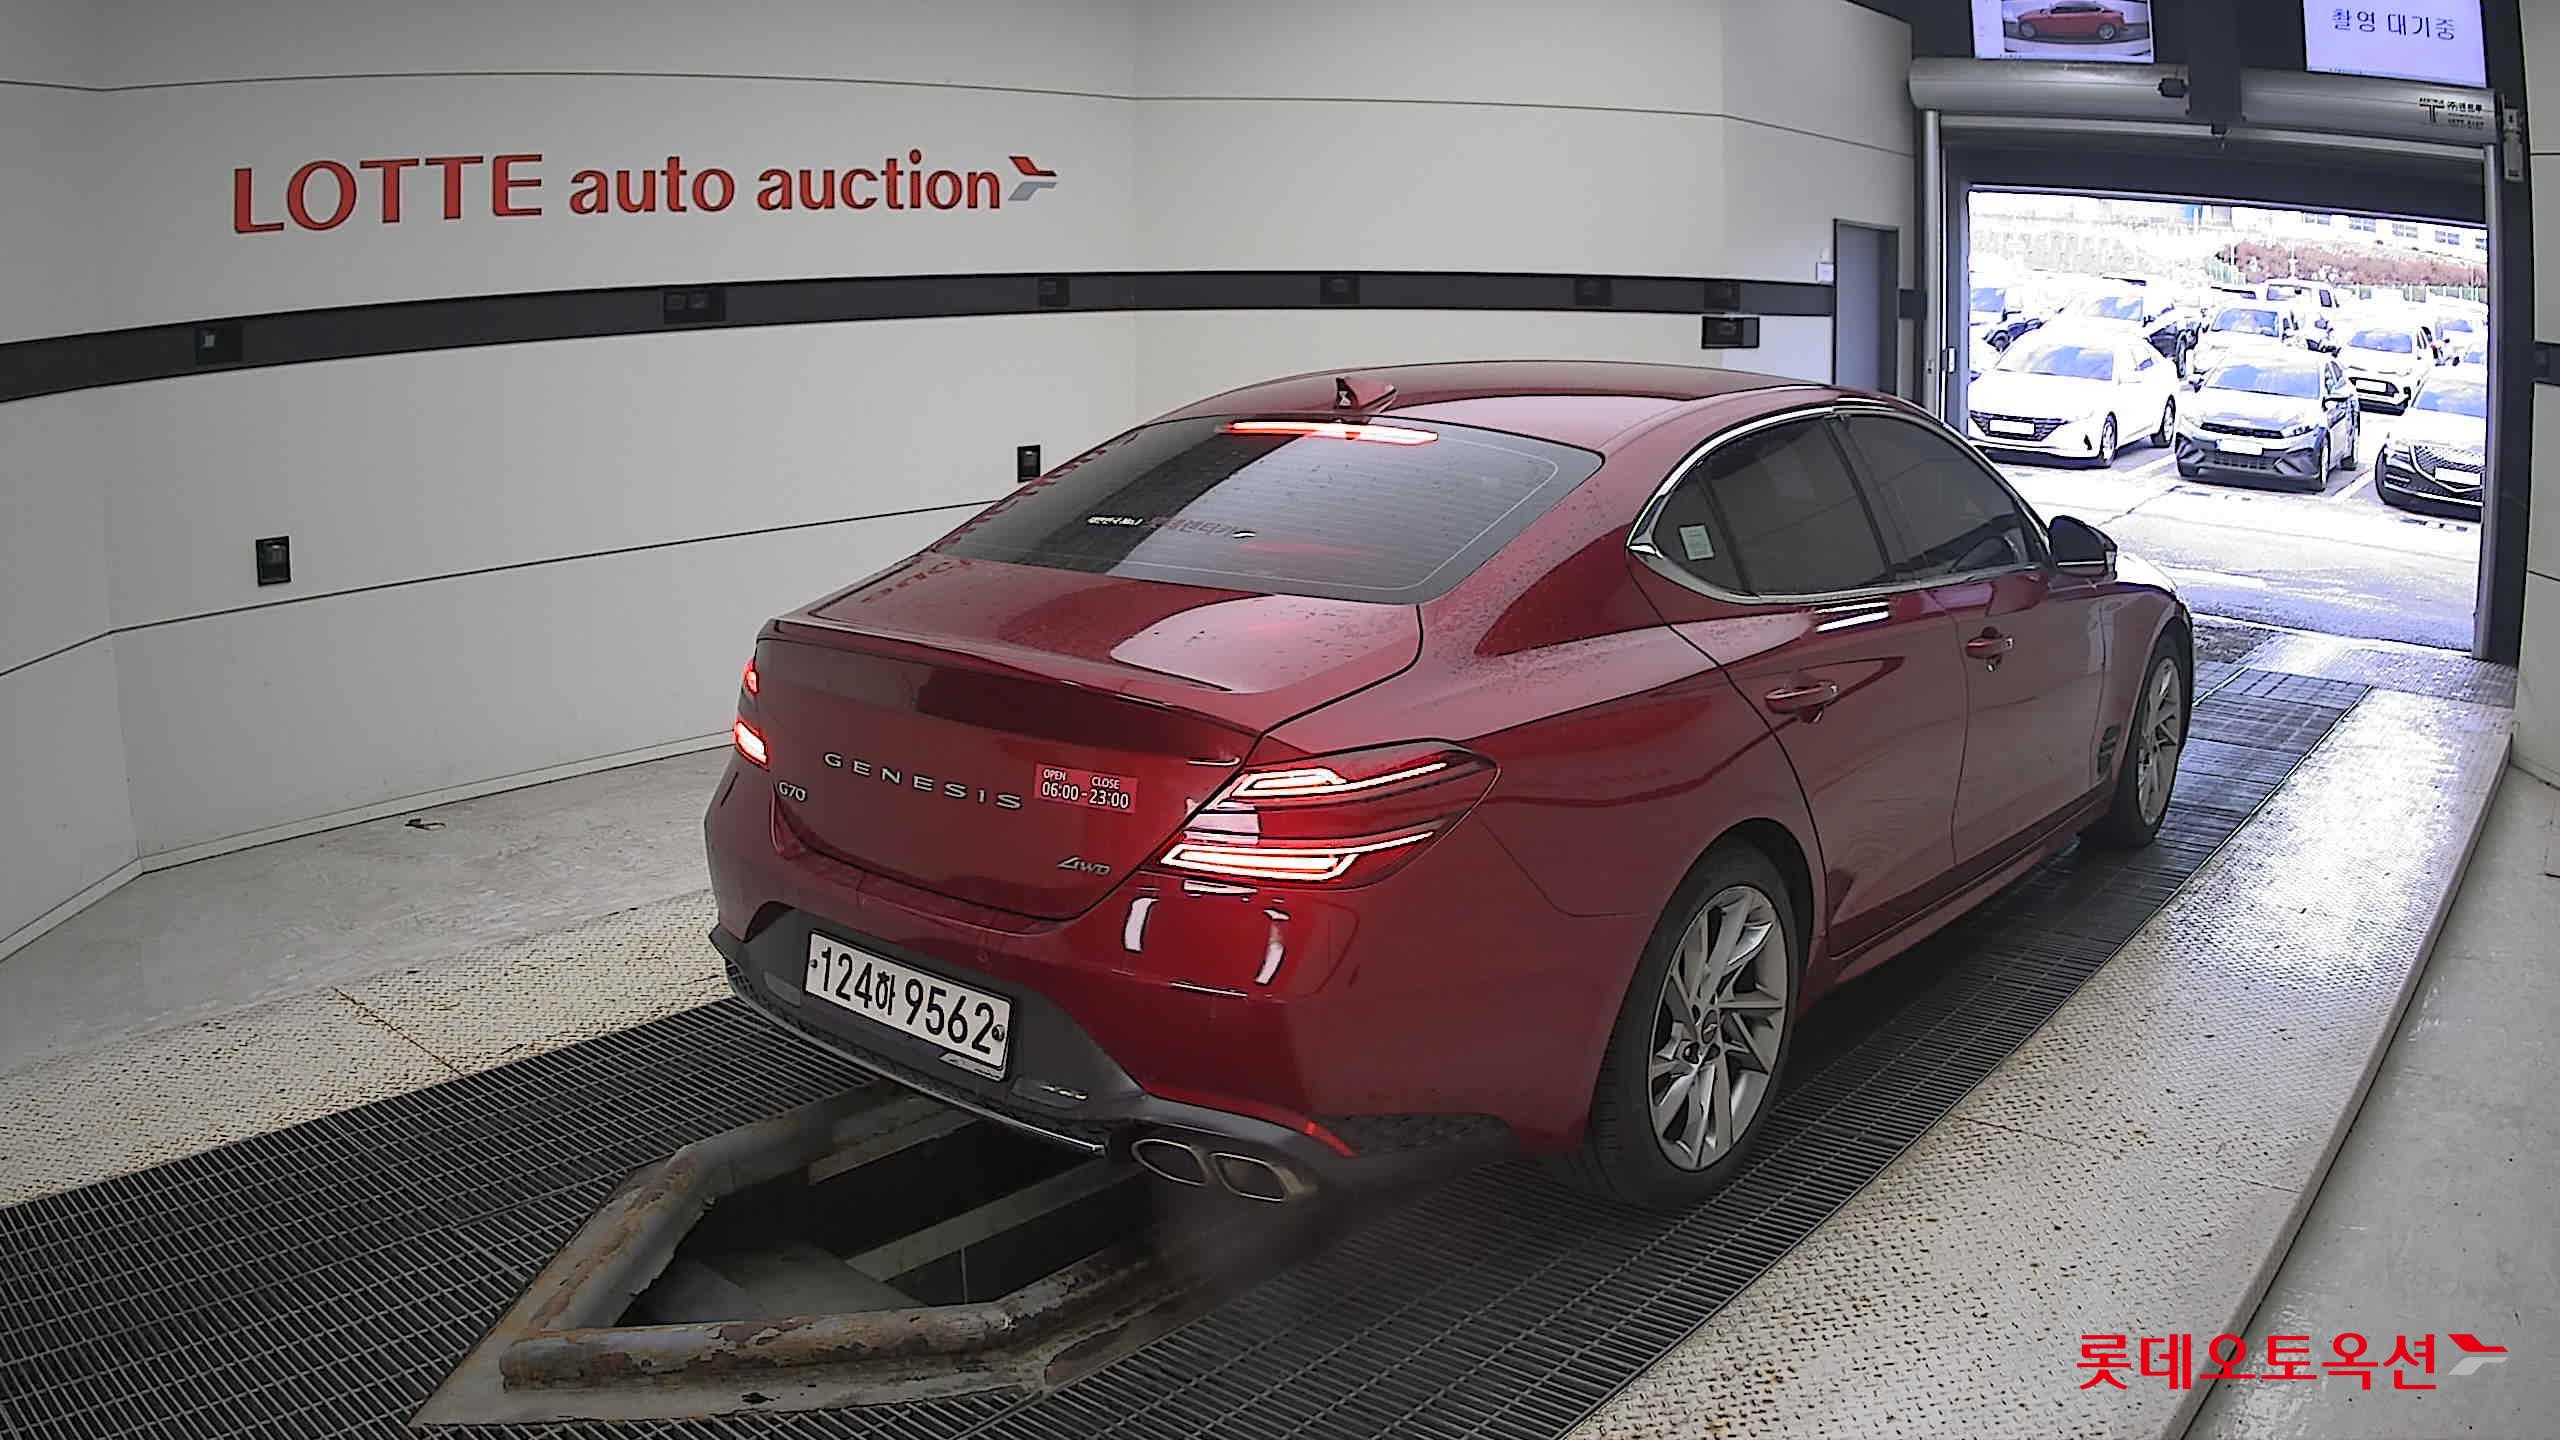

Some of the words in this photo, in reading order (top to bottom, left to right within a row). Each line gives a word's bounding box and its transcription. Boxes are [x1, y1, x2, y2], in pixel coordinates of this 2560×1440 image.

[2332, 8, 2376, 33] 촬영
[2387, 13, 2456, 41] 대기중
[234, 154, 543, 234] LOTTE
[569, 156, 735, 214] auto
[756, 149, 1001, 210] auction
[778, 782, 807, 801] G70
[824, 753, 1022, 809] GENESIS
[1043, 769, 1067, 781] OPEN
[1091, 776, 1120, 789] CLOSE
[1057, 856, 1110, 875] 4WD
[821, 947, 896, 1016] 124하
[904, 978, 995, 1055] 9562
